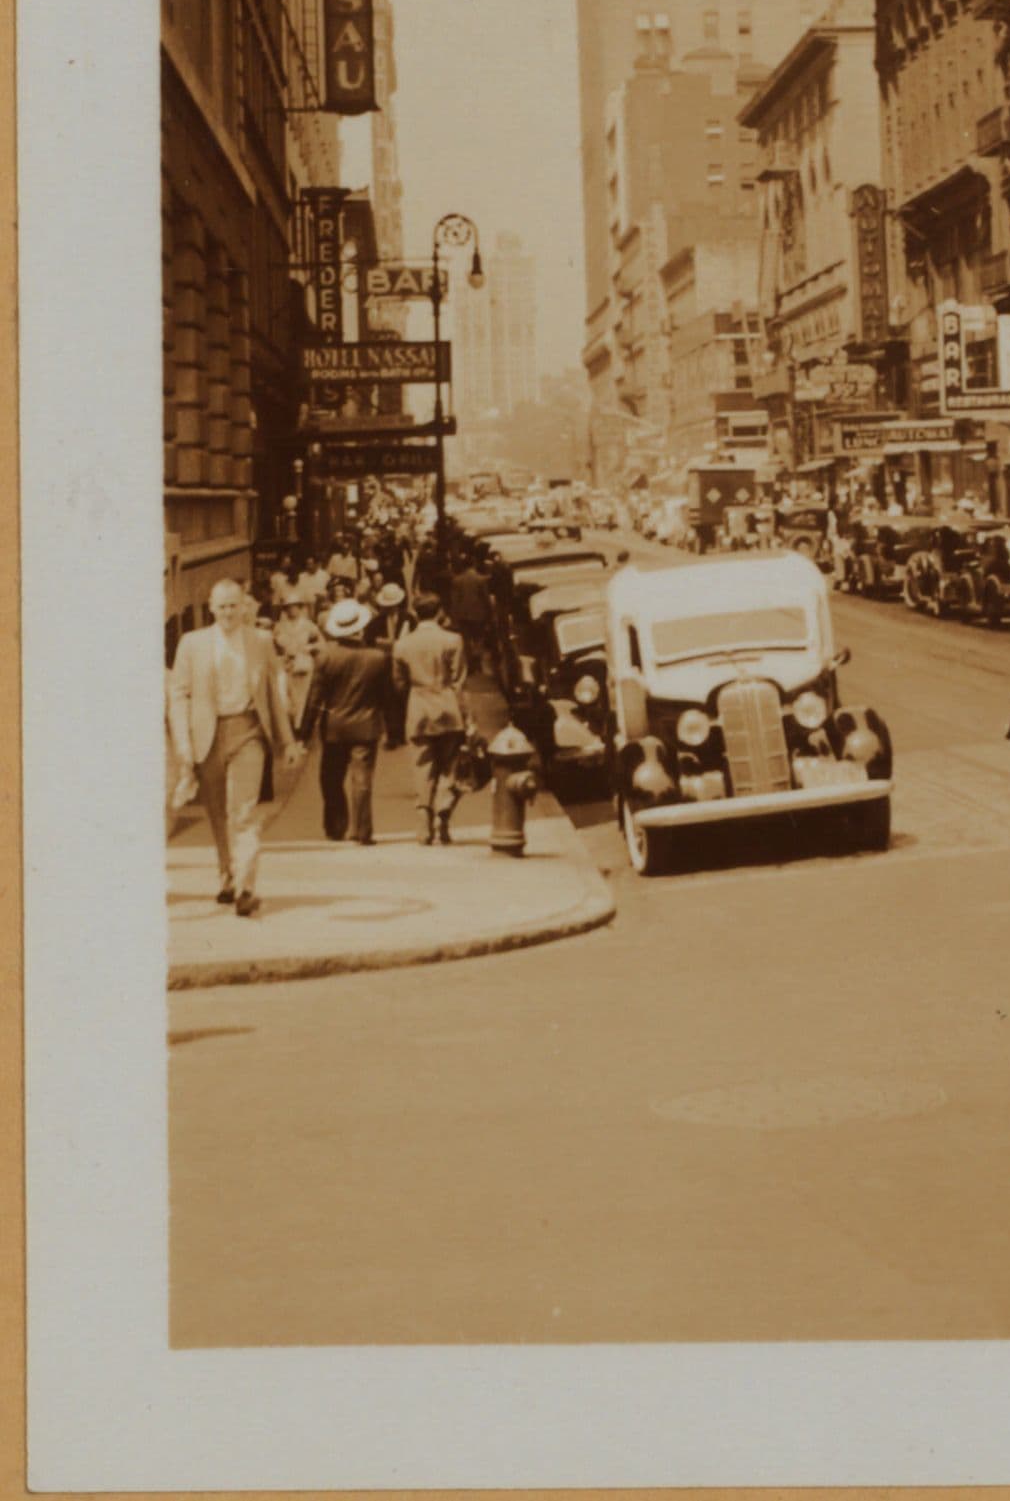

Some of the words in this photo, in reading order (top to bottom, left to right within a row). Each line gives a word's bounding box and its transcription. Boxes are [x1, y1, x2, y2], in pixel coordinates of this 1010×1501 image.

[367, 268, 448, 294] BAR
[858, 189, 881, 342] AUTOMAT
[303, 347, 362, 369] HOTEL
[943, 315, 960, 388] BAR
